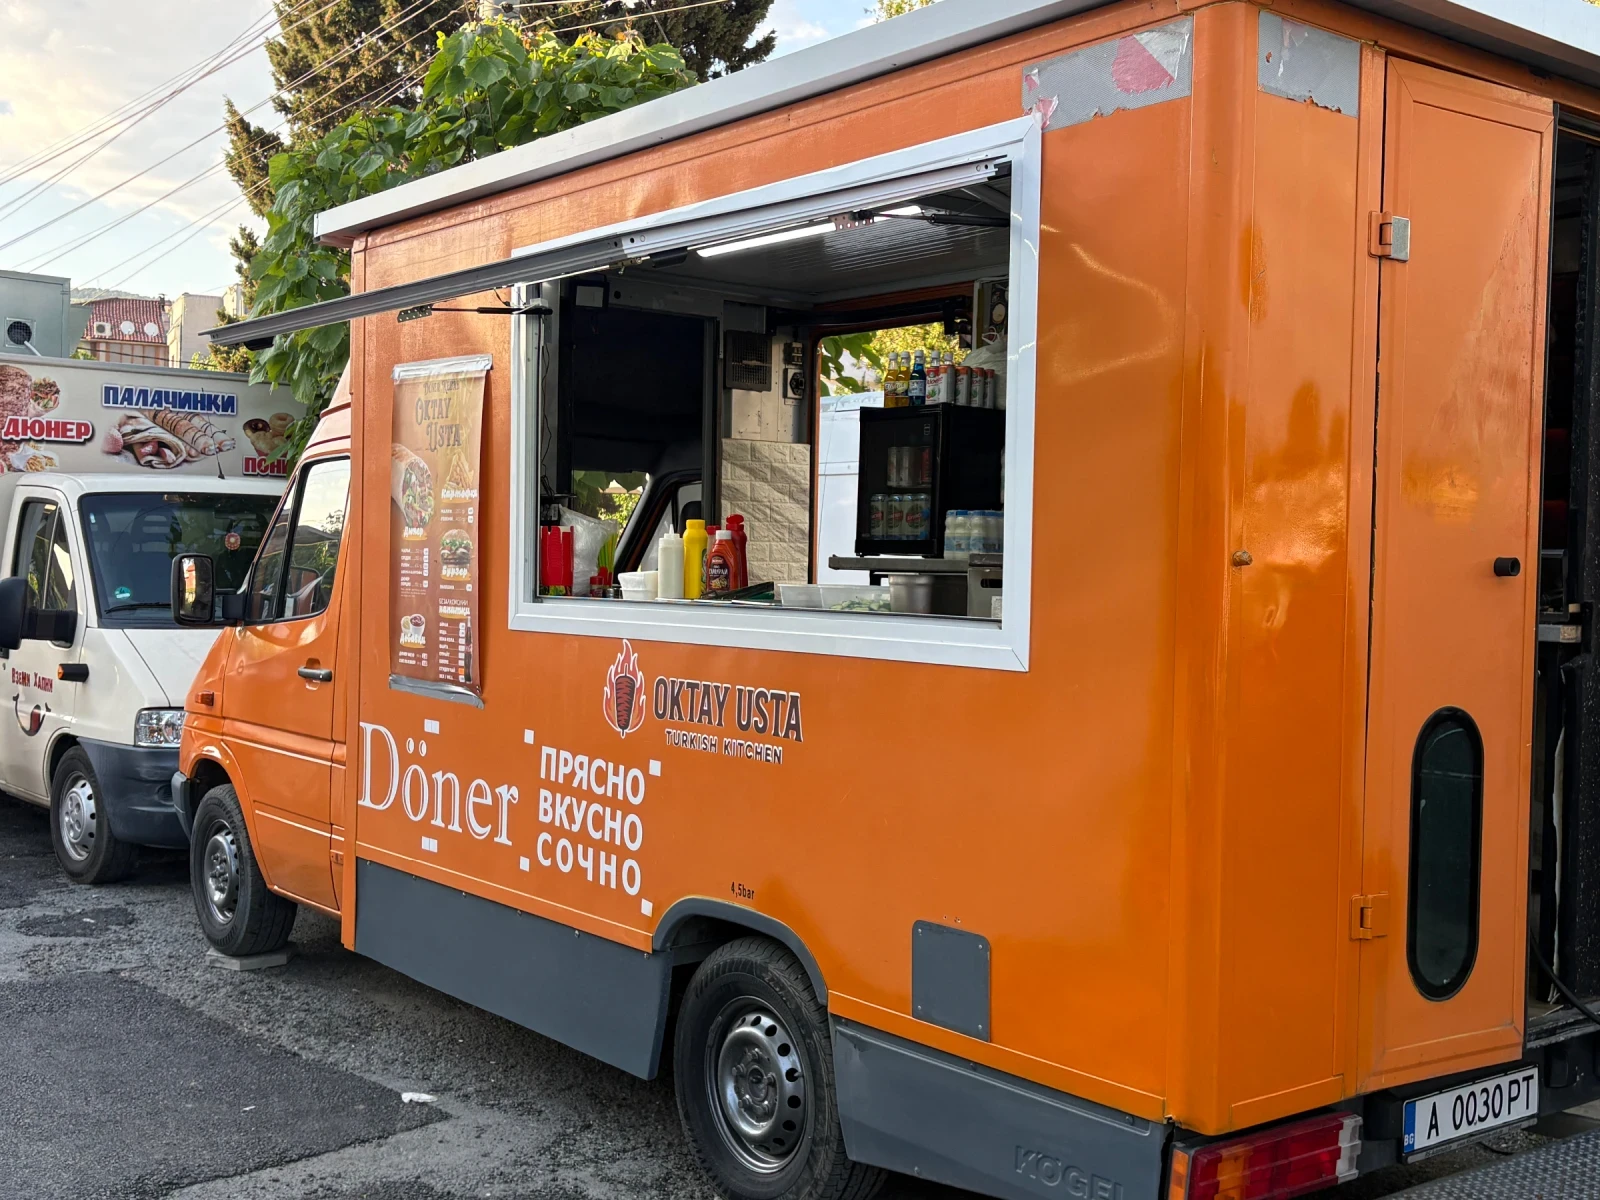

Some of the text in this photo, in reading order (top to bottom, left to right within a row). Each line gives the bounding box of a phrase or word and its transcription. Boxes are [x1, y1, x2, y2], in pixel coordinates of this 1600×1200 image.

[103, 385, 237, 414] ПАЛАЧИНКИ
[415, 397, 452, 426] OKTAY
[3, 416, 92, 441] ДЮНЕР
[426, 423, 462, 452] USTA
[653, 676, 804, 743] OKTAY USTA
[665, 728, 783, 765] TURKISH KITCHEN
[358, 721, 519, 846] Döner
[540, 745, 646, 805] ПРЯСНО
[538, 788, 643, 851] ВКУСНО
[536, 832, 641, 896] СОЧНО
[1404, 1133, 1414, 1146] BG
[1426, 1101, 1440, 1140] A
